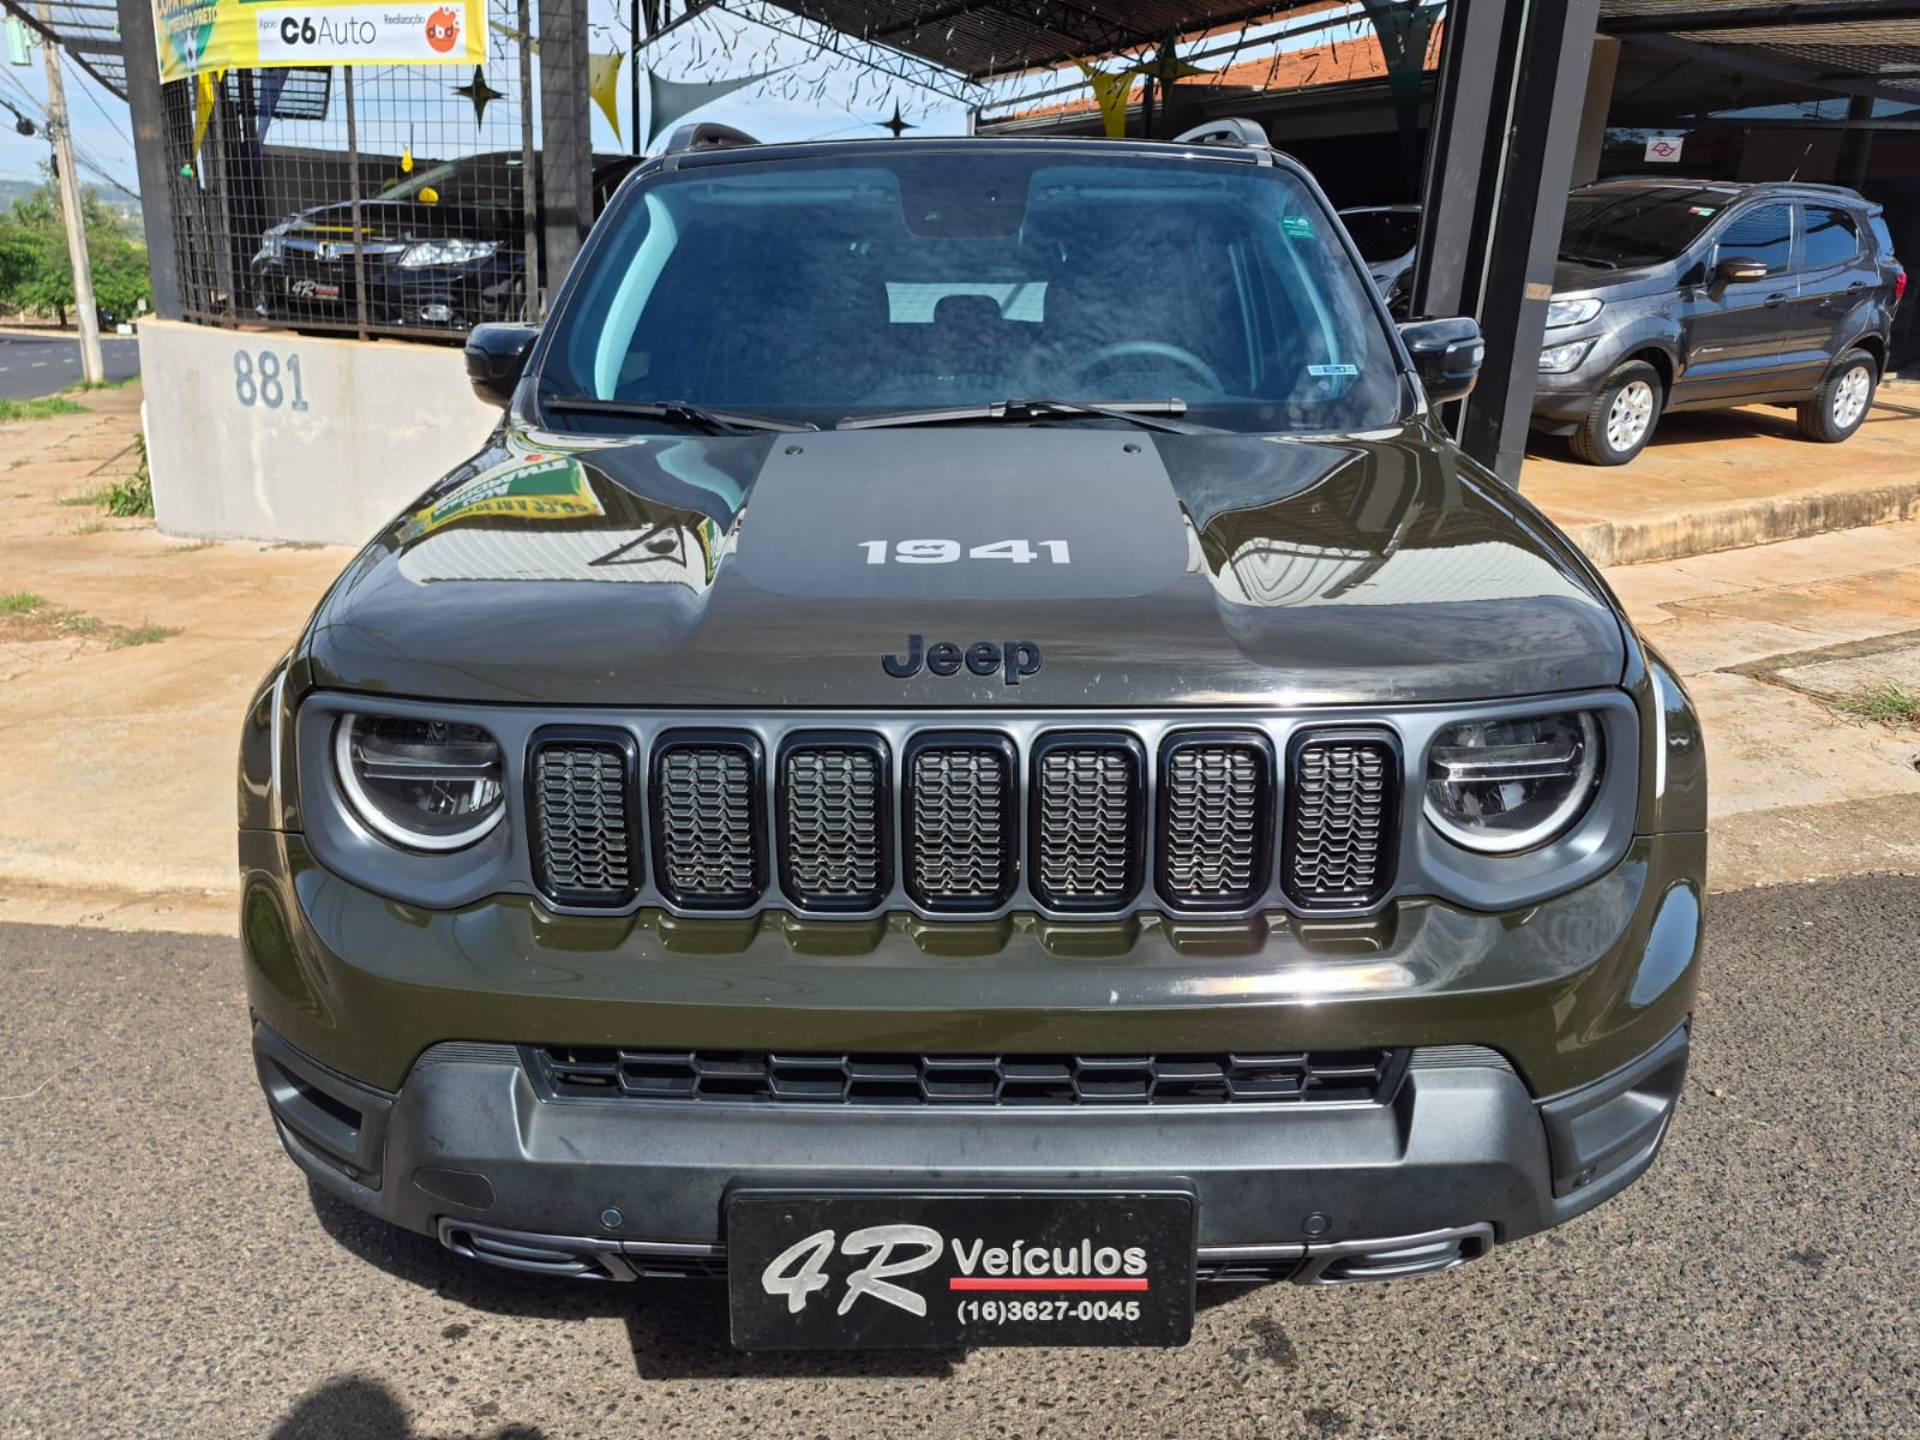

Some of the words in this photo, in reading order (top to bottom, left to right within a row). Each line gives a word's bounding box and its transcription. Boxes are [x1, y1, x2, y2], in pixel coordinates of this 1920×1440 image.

[233, 350, 309, 411] 881
[857, 539, 1071, 564] 1941
[881, 634, 1043, 685] Jeep
[761, 1224, 944, 1317] 4R
[951, 1238, 1148, 1276] Veículos
[957, 1301, 1140, 1325] (16)3627-0045
